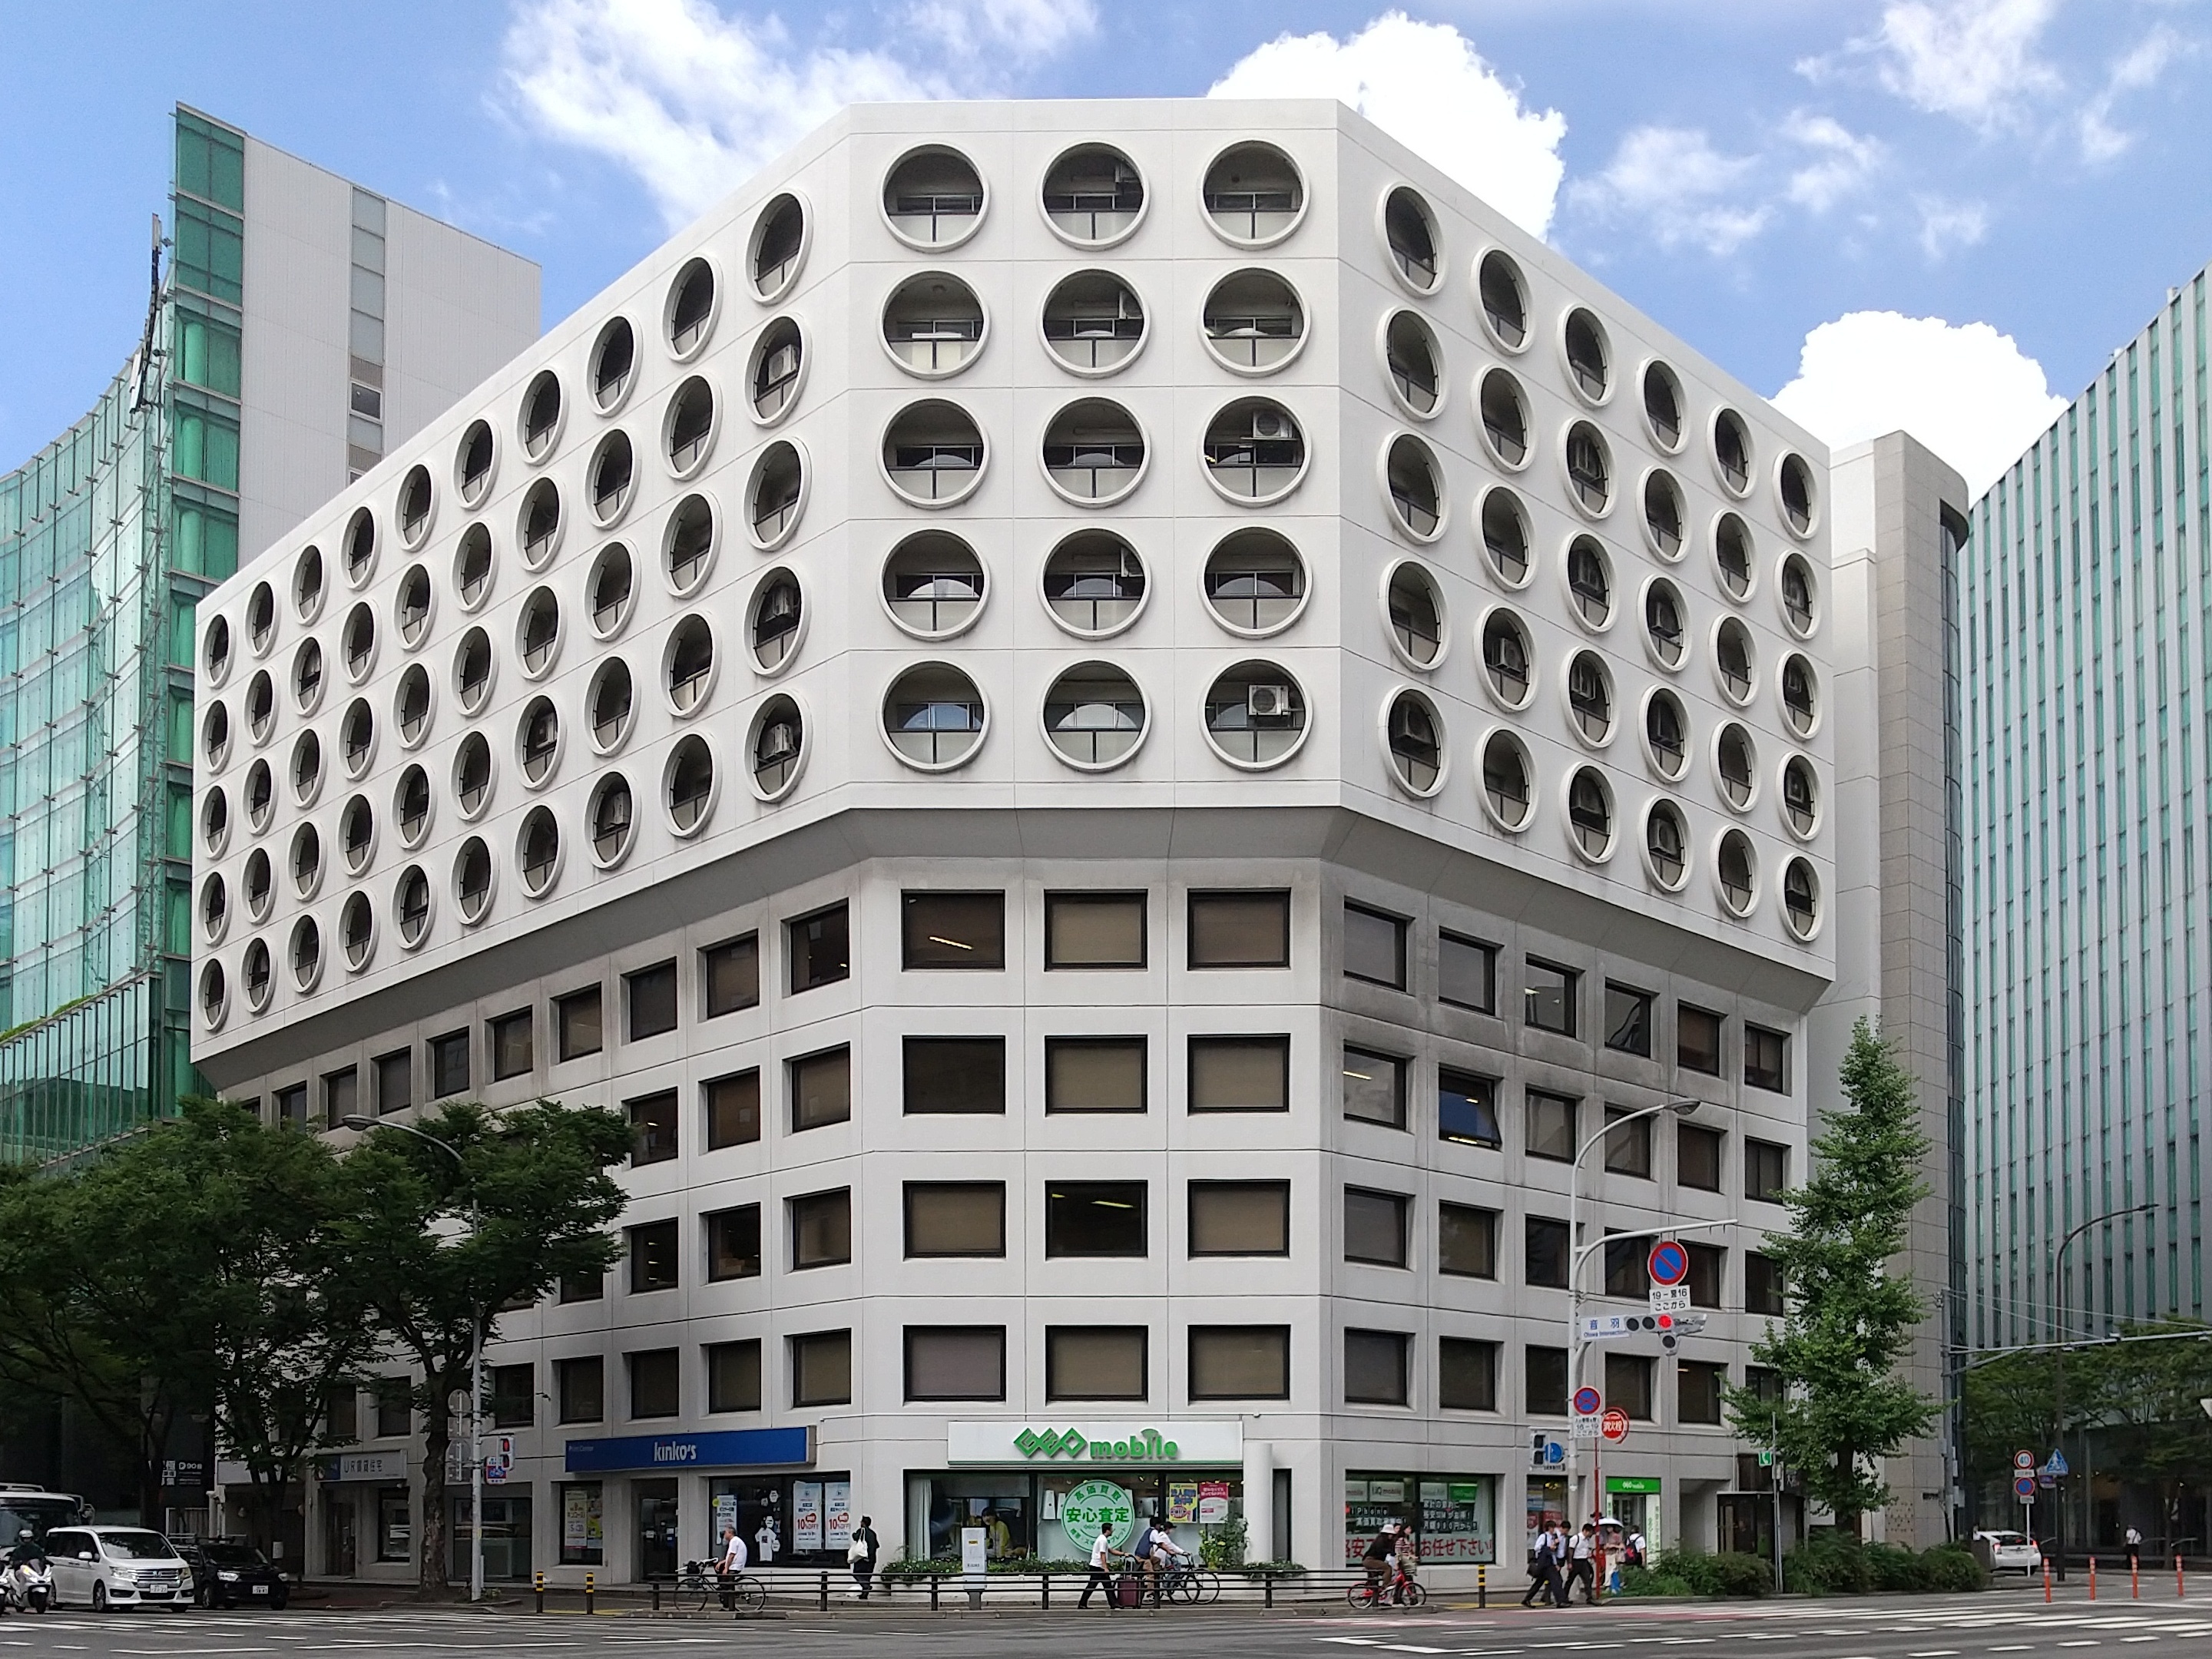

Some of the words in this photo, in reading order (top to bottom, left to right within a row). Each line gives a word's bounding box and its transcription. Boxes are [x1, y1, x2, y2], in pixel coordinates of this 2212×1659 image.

[1655, 1300, 1686, 1311] ここから
[1603, 1421, 1622, 1432] 消火栓
[1013, 1427, 1087, 1458] GEO
[1090, 1429, 1179, 1459] mobile
[654, 1441, 697, 1462] kinko's
[1074, 1485, 1122, 1501] 高価買取
[1066, 1507, 1130, 1522] 安心査定
